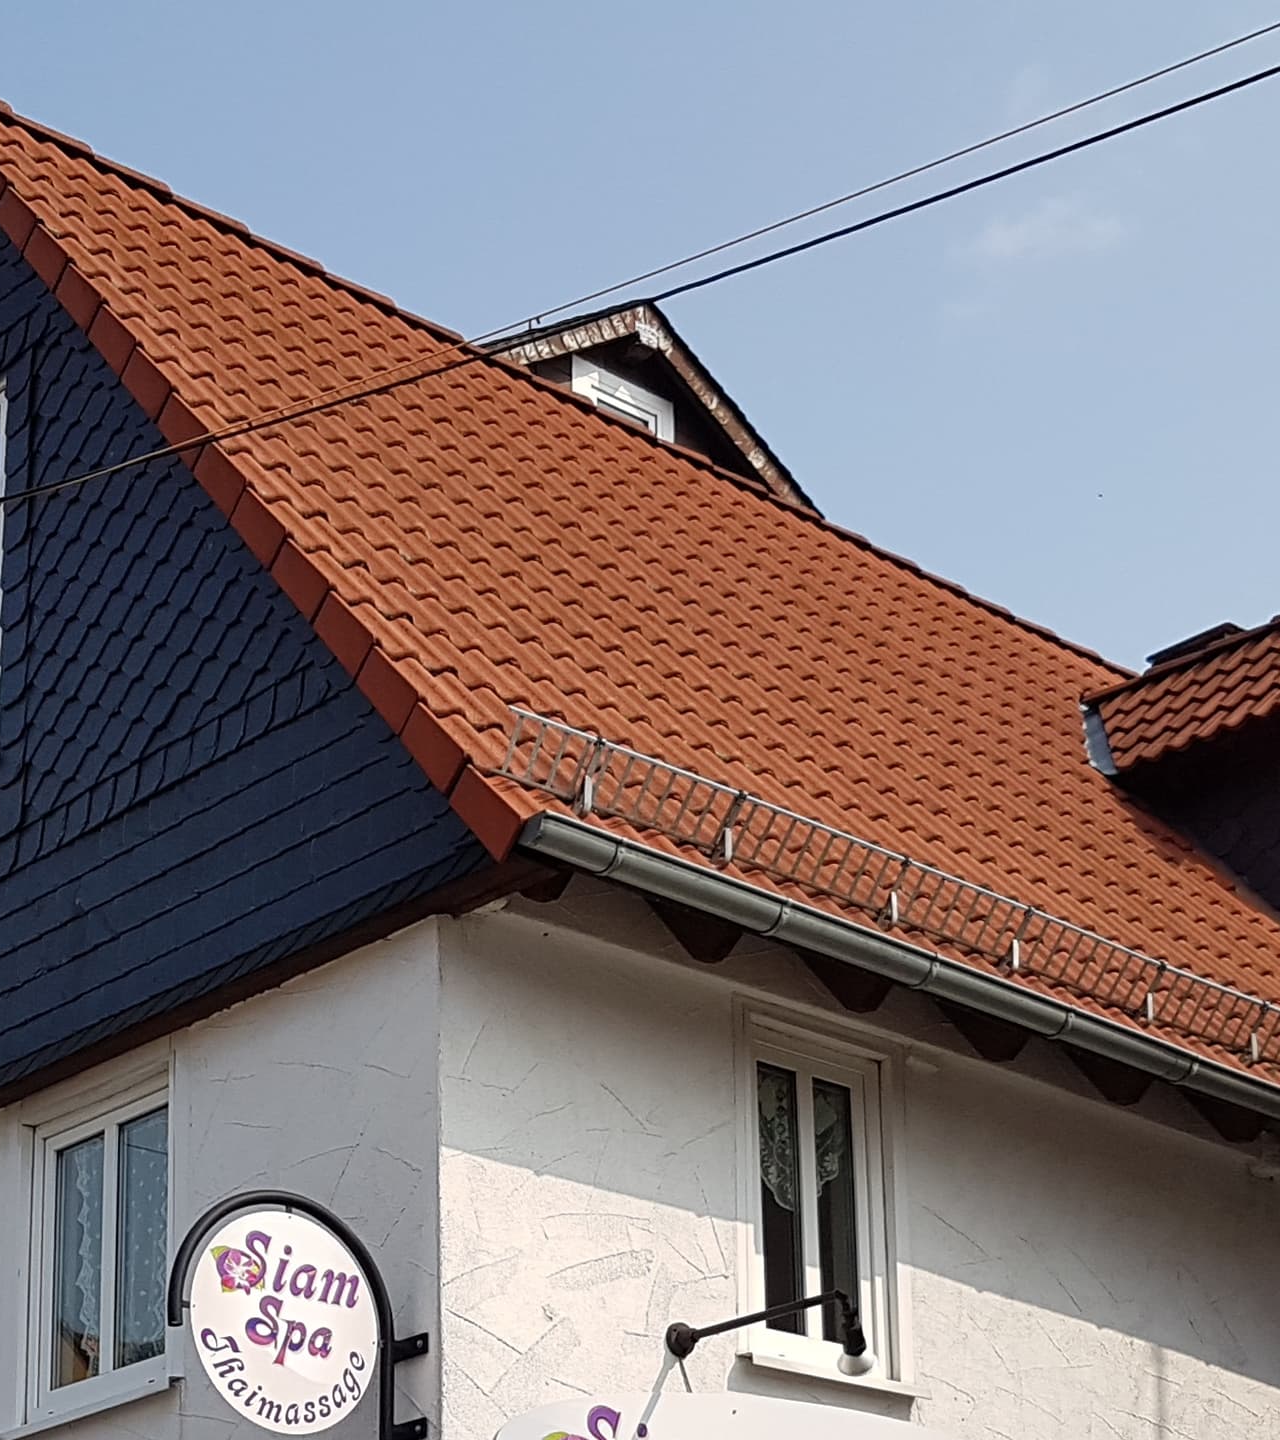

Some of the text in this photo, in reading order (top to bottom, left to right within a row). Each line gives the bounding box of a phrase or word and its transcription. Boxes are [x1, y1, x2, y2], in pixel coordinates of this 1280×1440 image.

[216, 1229, 361, 1310] Siam
[244, 1294, 334, 1367] Spa
[200, 1327, 366, 1426] Thaimassage
